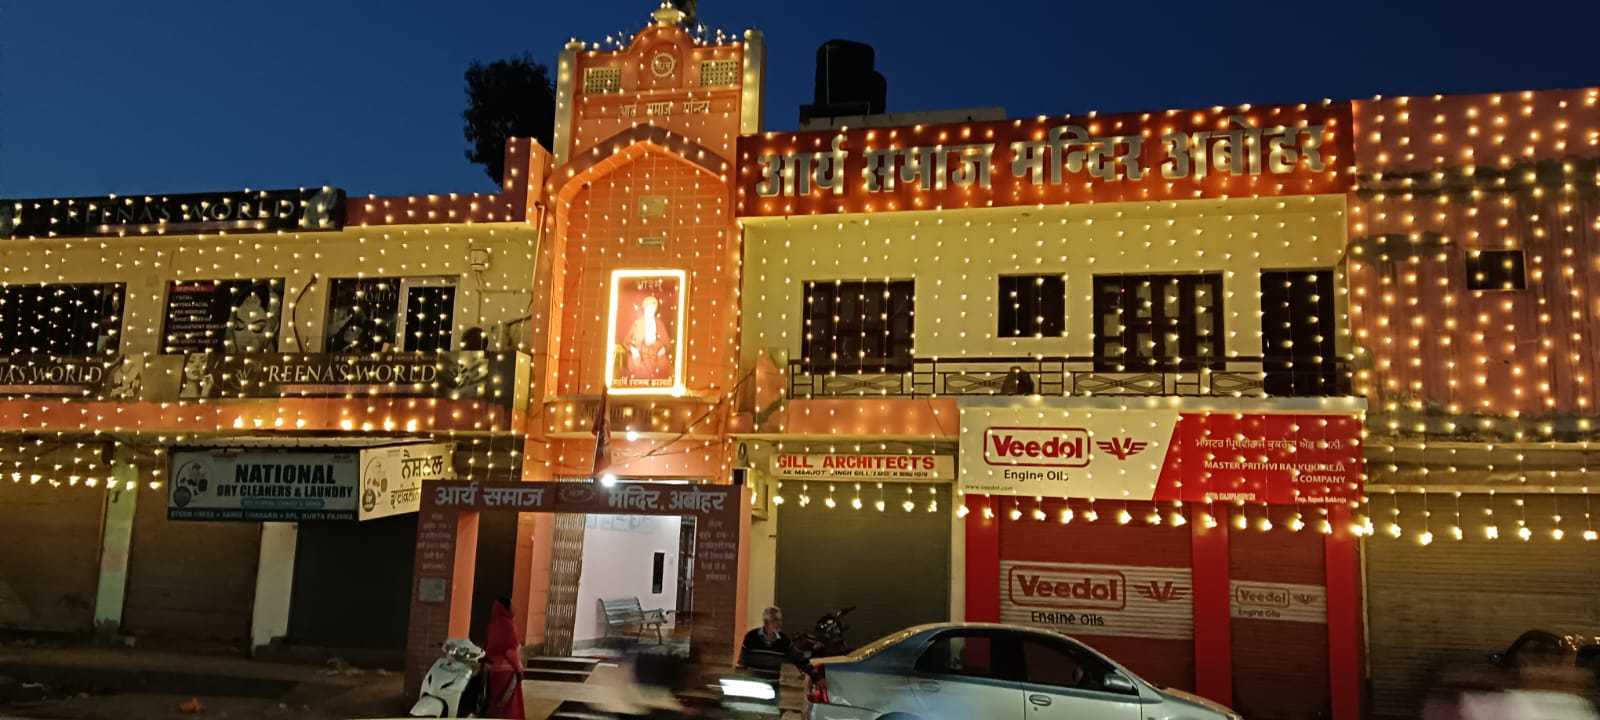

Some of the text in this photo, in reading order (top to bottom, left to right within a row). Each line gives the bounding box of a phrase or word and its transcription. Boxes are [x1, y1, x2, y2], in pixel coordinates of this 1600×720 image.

[756, 115, 1327, 197] आर्य समाज मन्दिर अबोहर
[184, 200, 294, 221] WORLD
[28, 365, 102, 383] WORLD
[268, 363, 437, 383] REENA'S WORLD
[992, 435, 1083, 459] Veedol
[777, 455, 935, 470] GILL ARCHITECTS
[1204, 461, 1240, 470] MASTER
[1242, 462, 1278, 471] PRITHVI
[235, 464, 336, 485] NATIONAL
[1004, 469, 1043, 482] Engine
[1299, 475, 1346, 484] COMPANY
[217, 485, 353, 499] DRY CLEANERS & LAUNDRY
[435, 482, 479, 507] आर्य
[483, 487, 545, 508] समाज
[669, 485, 728, 513] अबोहर
[1016, 574, 1118, 601] Veedol
[1240, 589, 1287, 602] Veedol
[1031, 610, 1104, 627] Engine Oils
[1238, 607, 1263, 617] Engine
